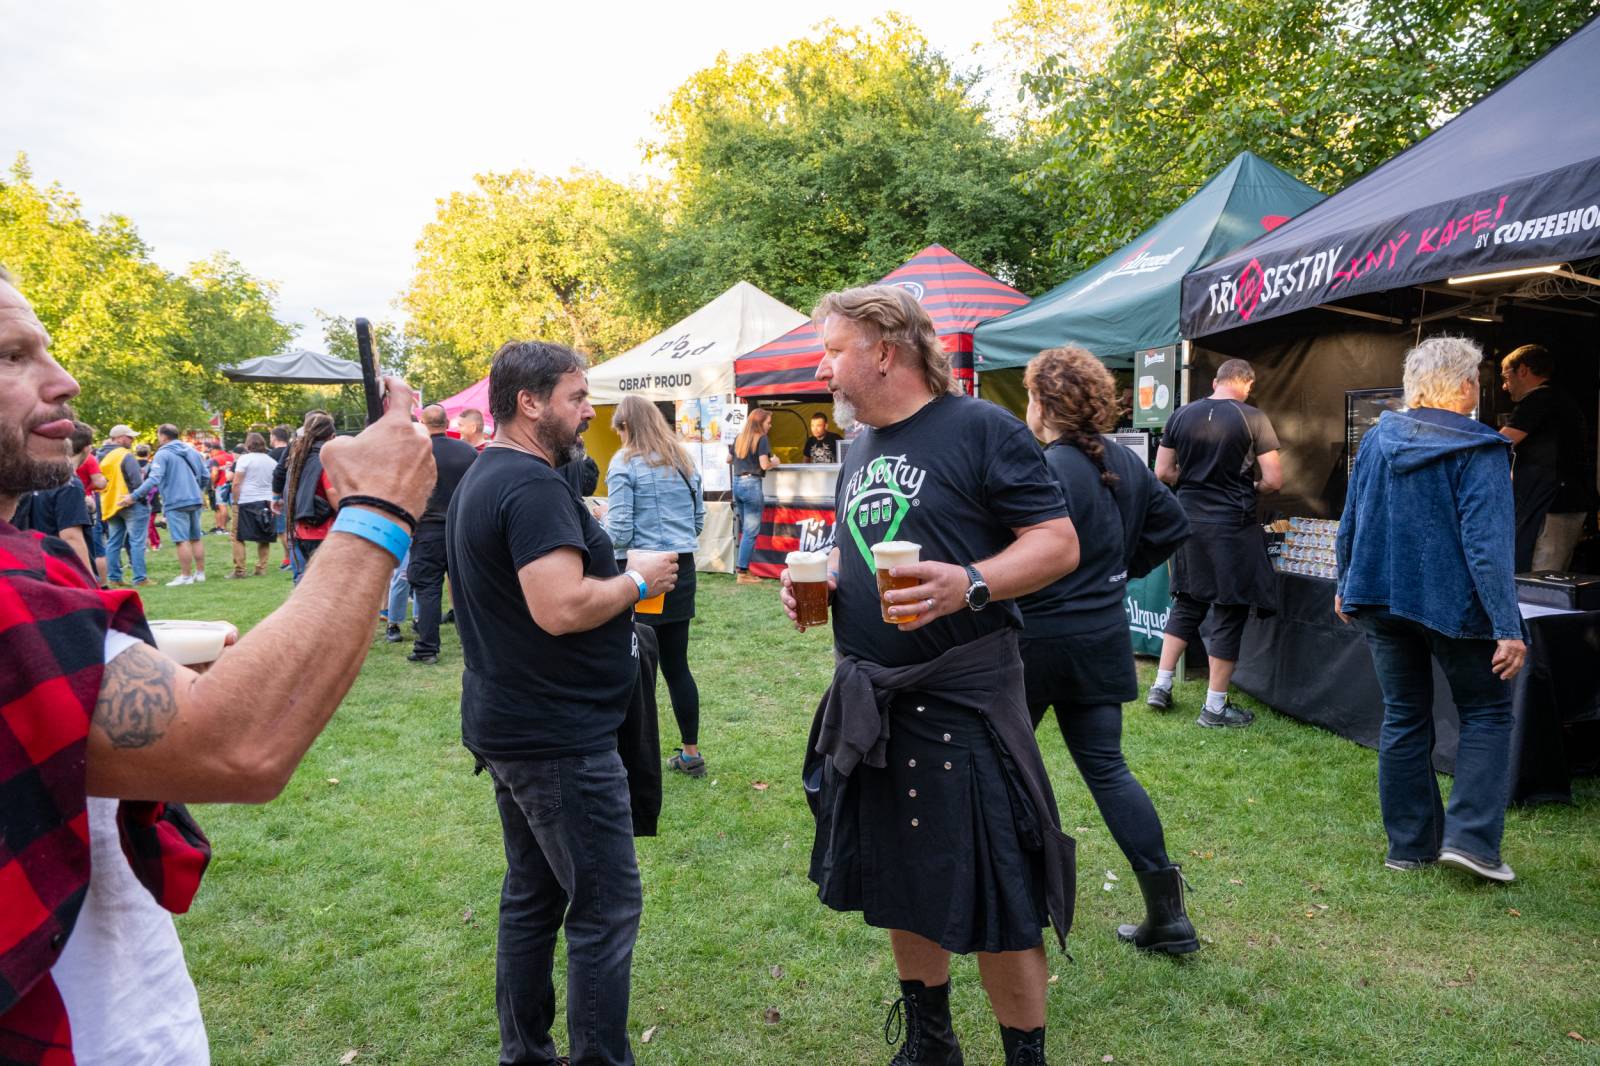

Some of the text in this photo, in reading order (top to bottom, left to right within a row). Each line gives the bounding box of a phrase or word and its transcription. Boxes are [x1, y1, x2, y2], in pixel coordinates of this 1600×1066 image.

[1475, 204, 1600, 249] BY COFFEEHO
[1208, 275, 1238, 316] TŘI
[1260, 244, 1344, 303] SESTRY
[1415, 195, 1509, 256] KAFE!
[654, 373, 691, 388] PROUD
